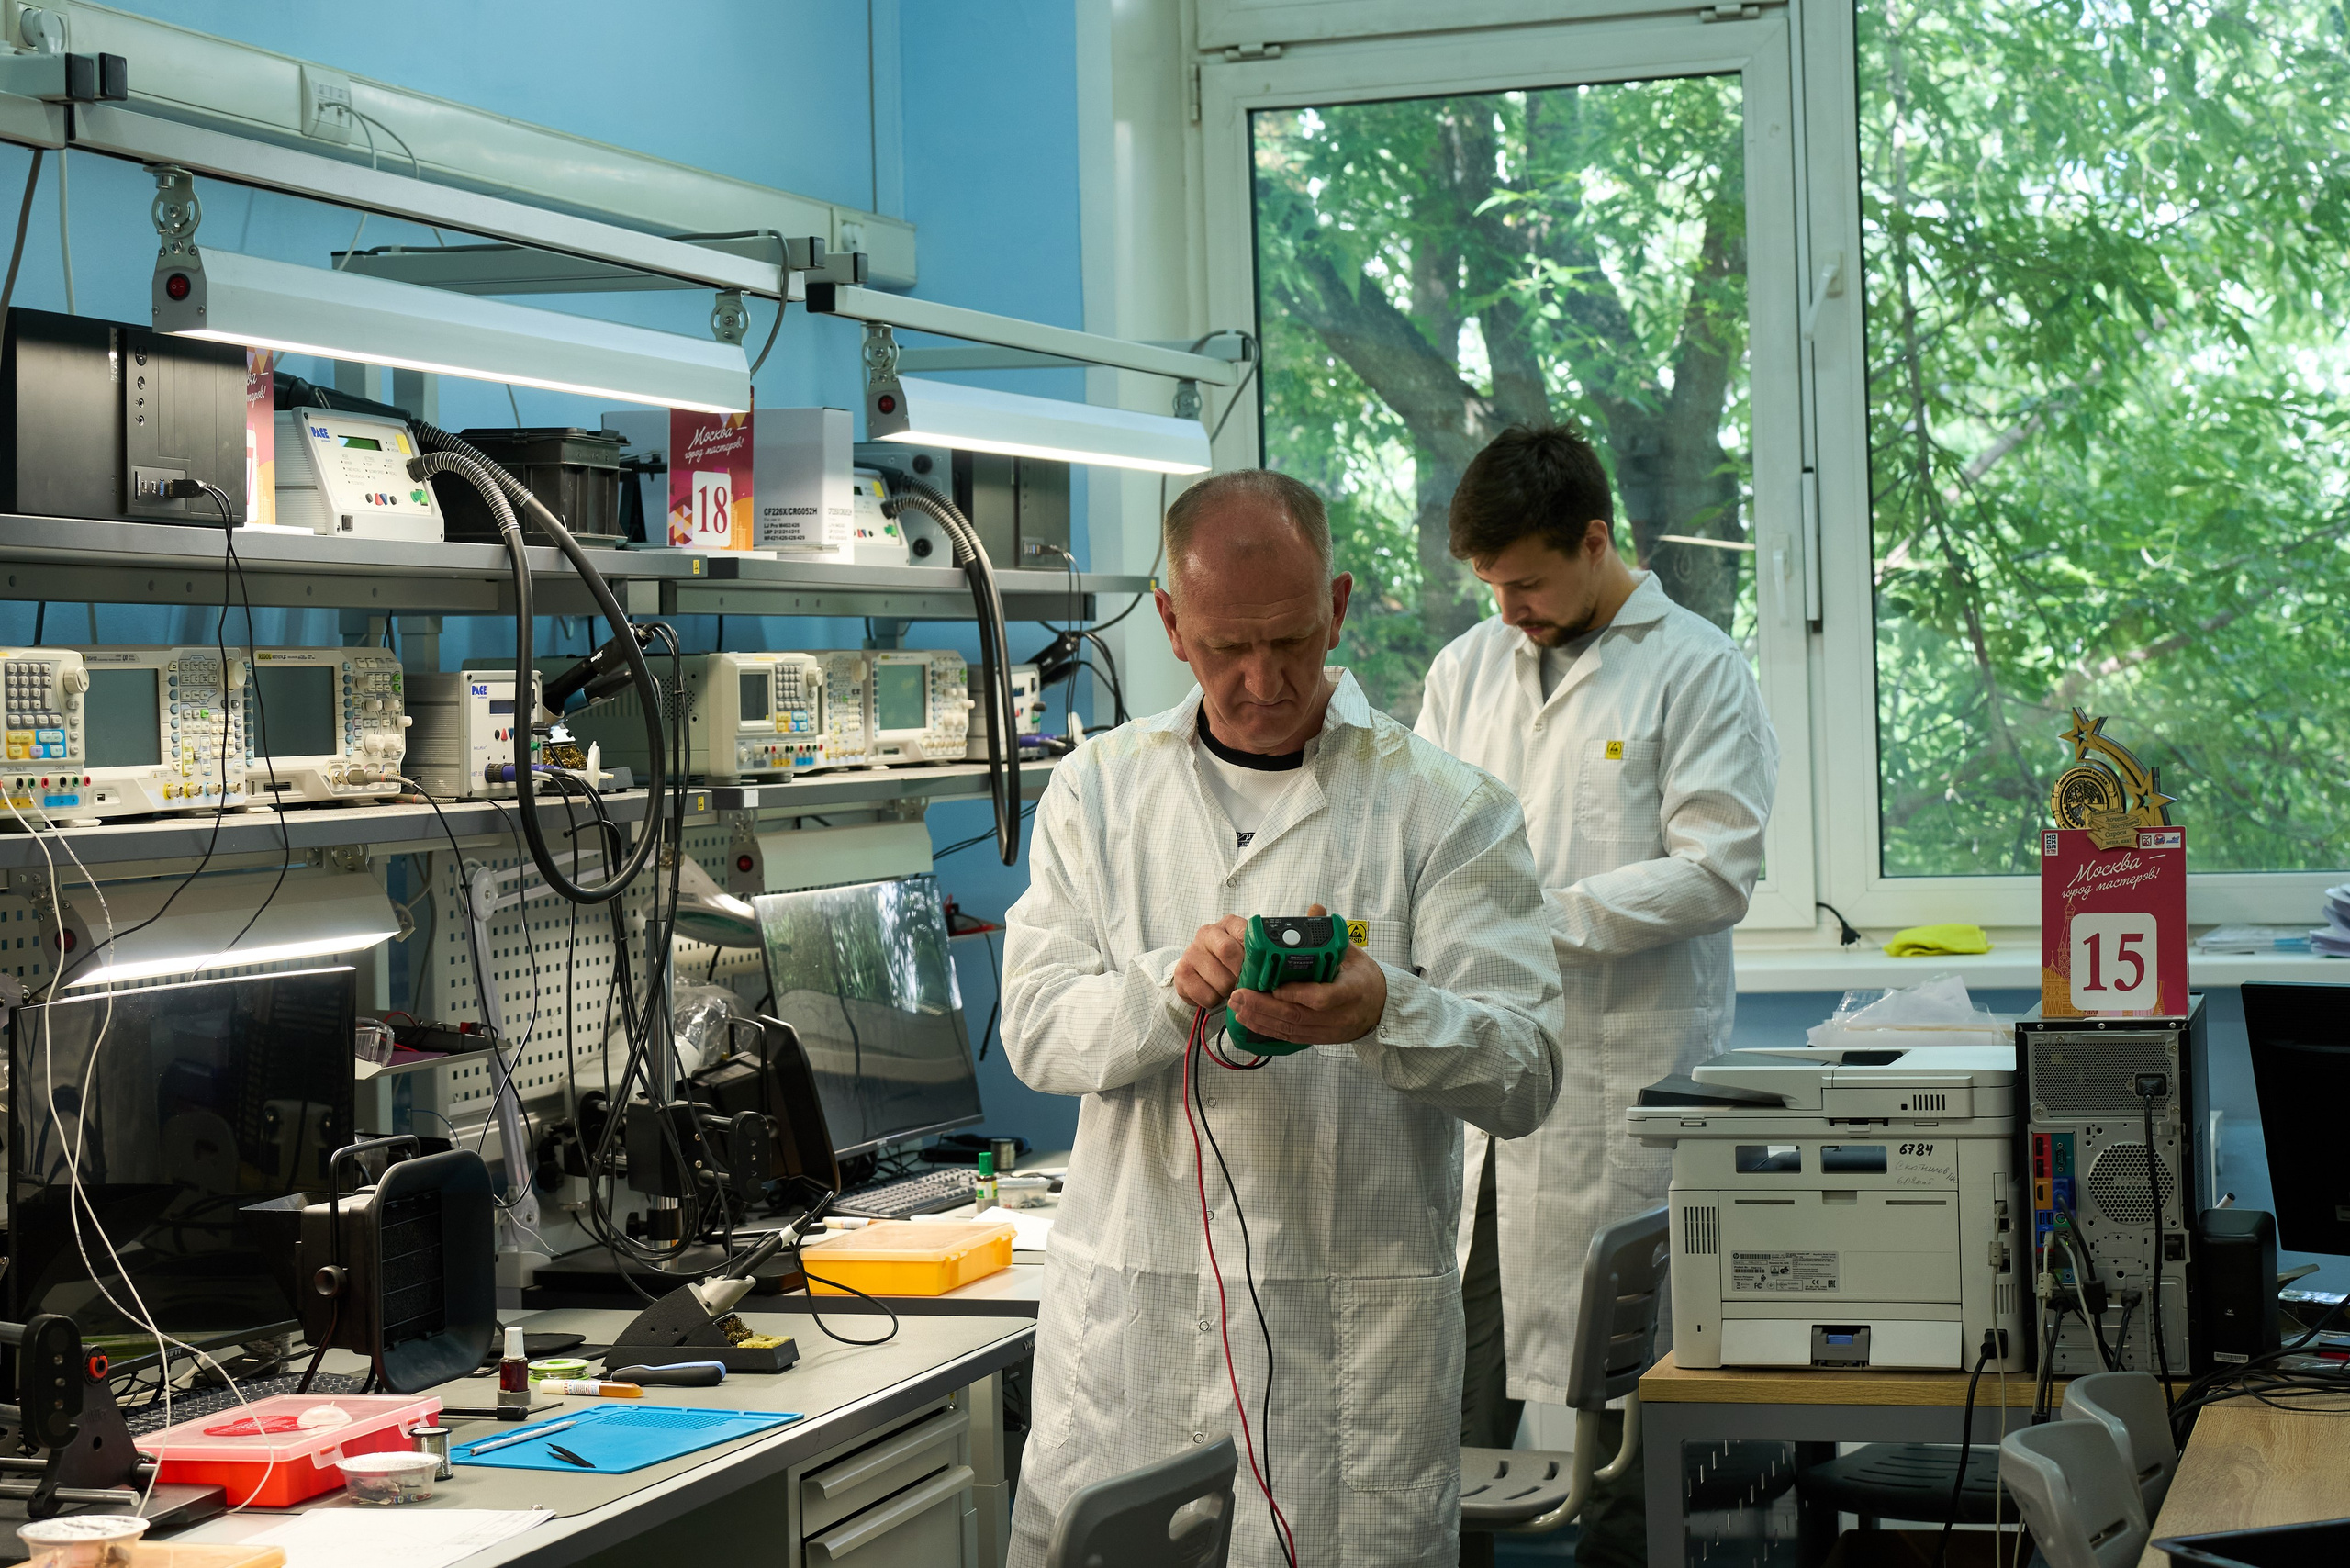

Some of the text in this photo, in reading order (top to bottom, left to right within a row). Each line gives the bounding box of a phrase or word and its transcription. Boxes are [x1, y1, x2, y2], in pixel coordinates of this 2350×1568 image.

[310, 426, 330, 439] PACE
[688, 421, 733, 449] Москва
[684, 436, 744, 465] город мастеров!
[698, 485, 728, 534] 18
[471, 685, 487, 696] PACE
[2105, 830, 2127, 838] Спроси
[2066, 851, 2143, 889] Москва
[2061, 867, 2161, 902] город мастеров!
[2082, 932, 2145, 991] 15
[1899, 1142, 1934, 1157] 6784
